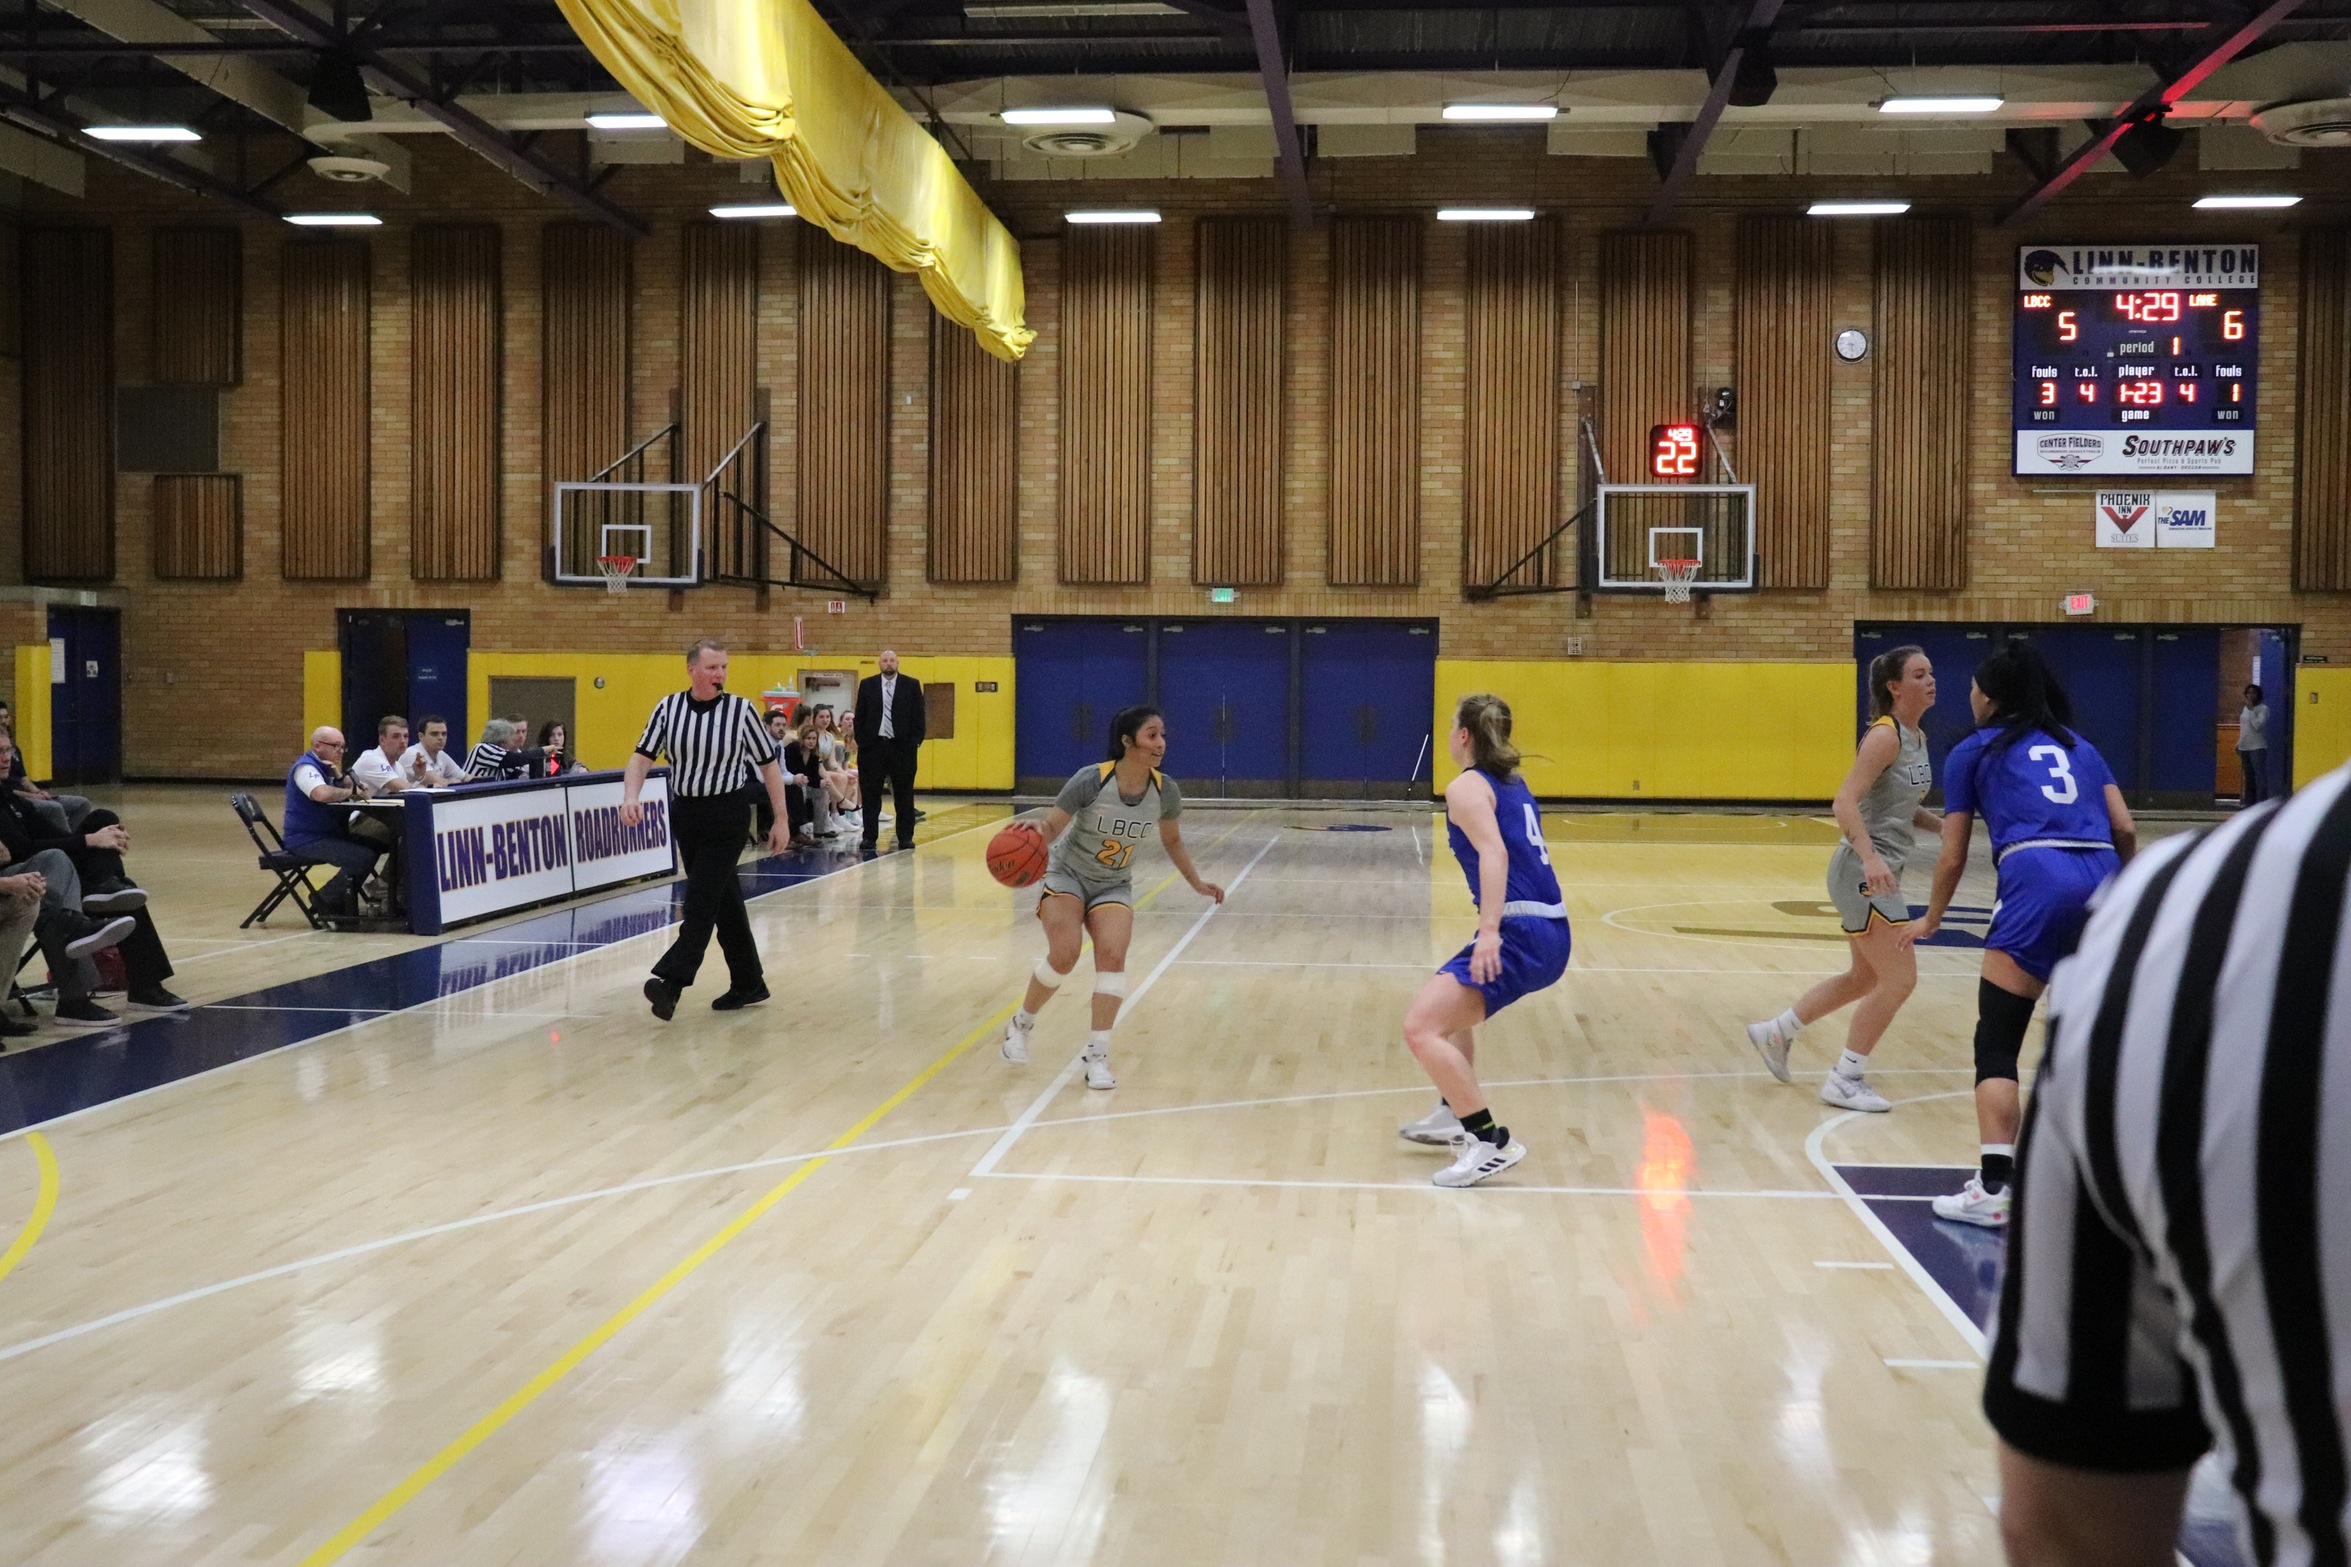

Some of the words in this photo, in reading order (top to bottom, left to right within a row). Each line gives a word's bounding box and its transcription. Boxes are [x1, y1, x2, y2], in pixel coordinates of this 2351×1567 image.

[2073, 276, 2171, 284] COMMUNITY
[2185, 275, 2256, 284] COLLEGE
[2115, 292, 2179, 321] 4:29
[2058, 311, 2077, 341] 5
[2223, 310, 2243, 340] 6
[2120, 341, 2155, 356] period
[2172, 336, 2180, 356] 1
[2032, 365, 2058, 378] fouls
[2074, 366, 2098, 377] t.o.l.
[2118, 364, 2155, 378] player
[2174, 365, 2198, 377] t.o.l.
[2215, 364, 2242, 377] fouls
[2041, 382, 2055, 404] 3
[2079, 383, 2095, 403] 4
[2179, 383, 2195, 403] 4
[2231, 383, 2240, 403] 1
[2033, 411, 2055, 420] won
[2121, 410, 2150, 422] game
[2217, 410, 2239, 420] won
[2039, 438, 2067, 448] CENTER
[1656, 441, 1697, 473] 22
[2100, 494, 2151, 506] PHOENIX
[2118, 506, 2132, 514] INN
[2169, 510, 2206, 526] SAM
[2111, 534, 2139, 543] SUITES
[2071, 595, 2089, 610] EXIT
[2028, 744, 2079, 804] 3
[1097, 814, 1152, 839] LBCC
[1523, 803, 1549, 865] 4
[436, 813, 569, 893] LINN-BENTON
[1095, 839, 1136, 868] 21
